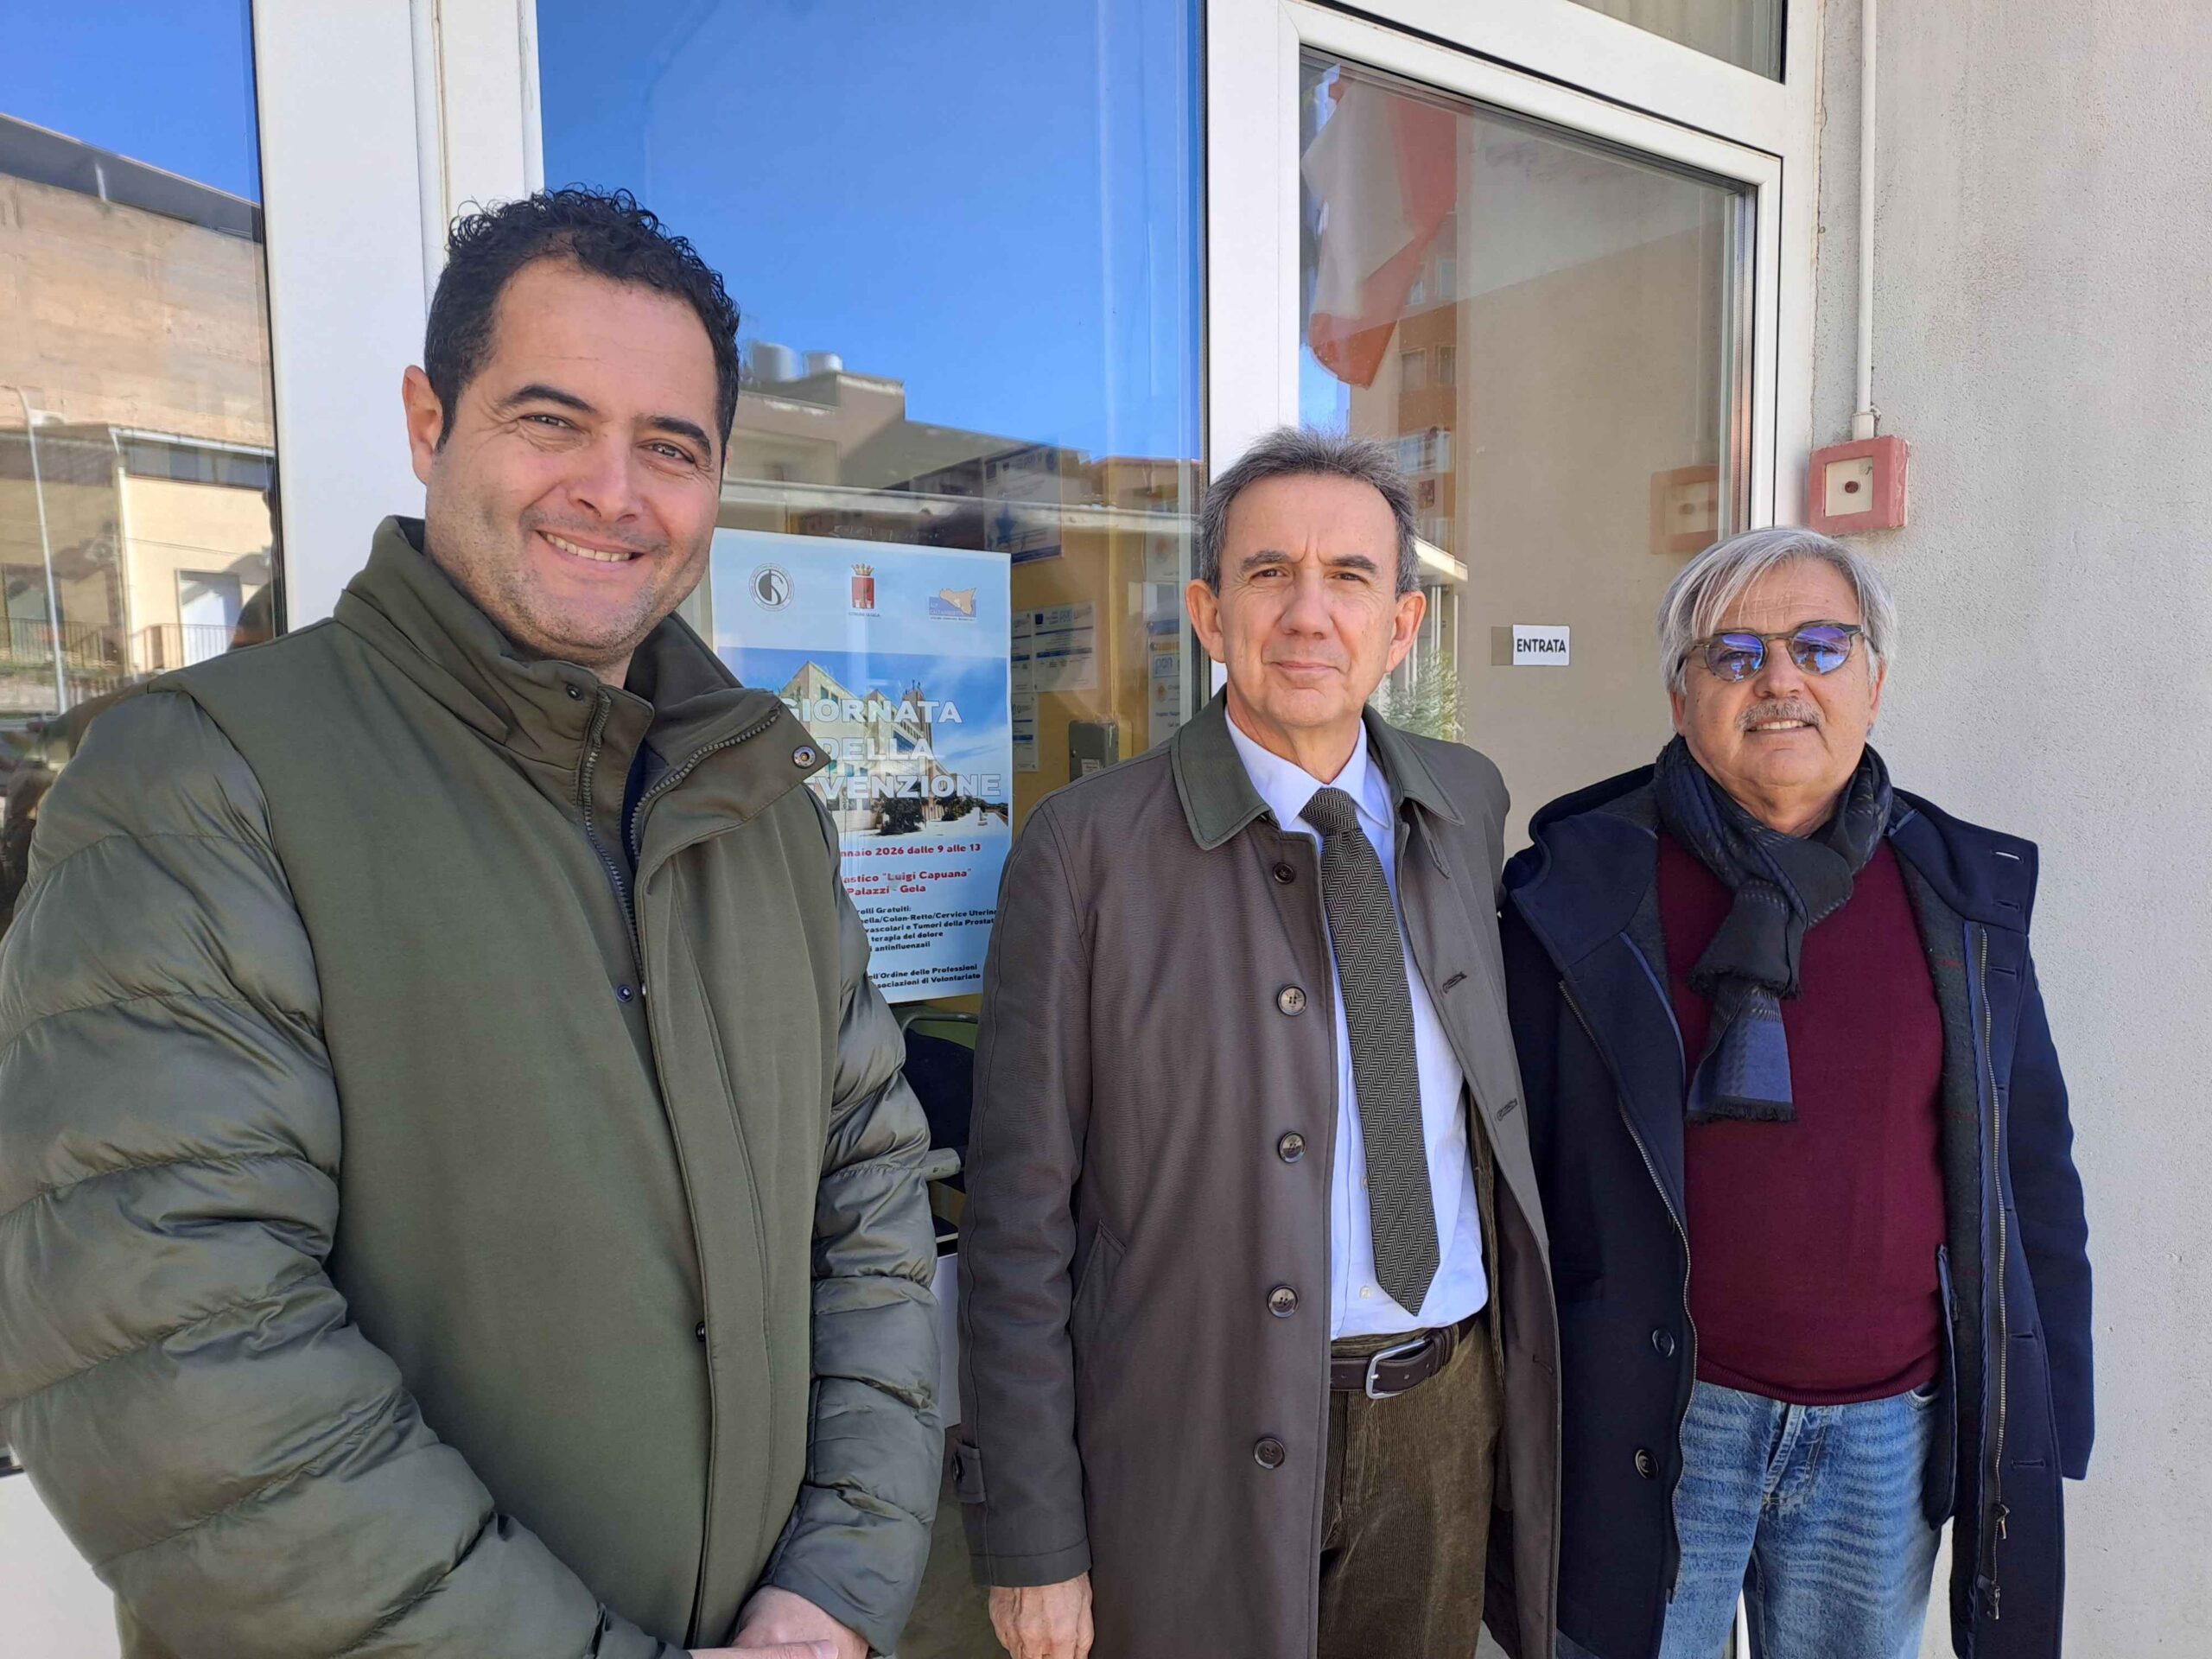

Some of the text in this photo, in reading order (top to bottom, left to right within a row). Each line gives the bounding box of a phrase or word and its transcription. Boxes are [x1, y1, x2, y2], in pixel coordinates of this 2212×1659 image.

[1516, 638, 1567, 653] ENTRATA
[817, 737, 936, 760] DELLA
[875, 847, 904, 856] 2026
[907, 846, 934, 855] dalle
[947, 844, 966, 853] alle
[969, 843, 981, 852] 13
[841, 874, 879, 883] astico
[919, 868, 971, 881] Capuana"
[847, 886, 890, 895] Palazzi
[899, 884, 926, 893] Gela
[871, 934, 901, 943] terapia
[874, 941, 931, 952] antinfluenzali
[931, 963, 977, 974] Professioni
[931, 973, 981, 983] Volontariato
